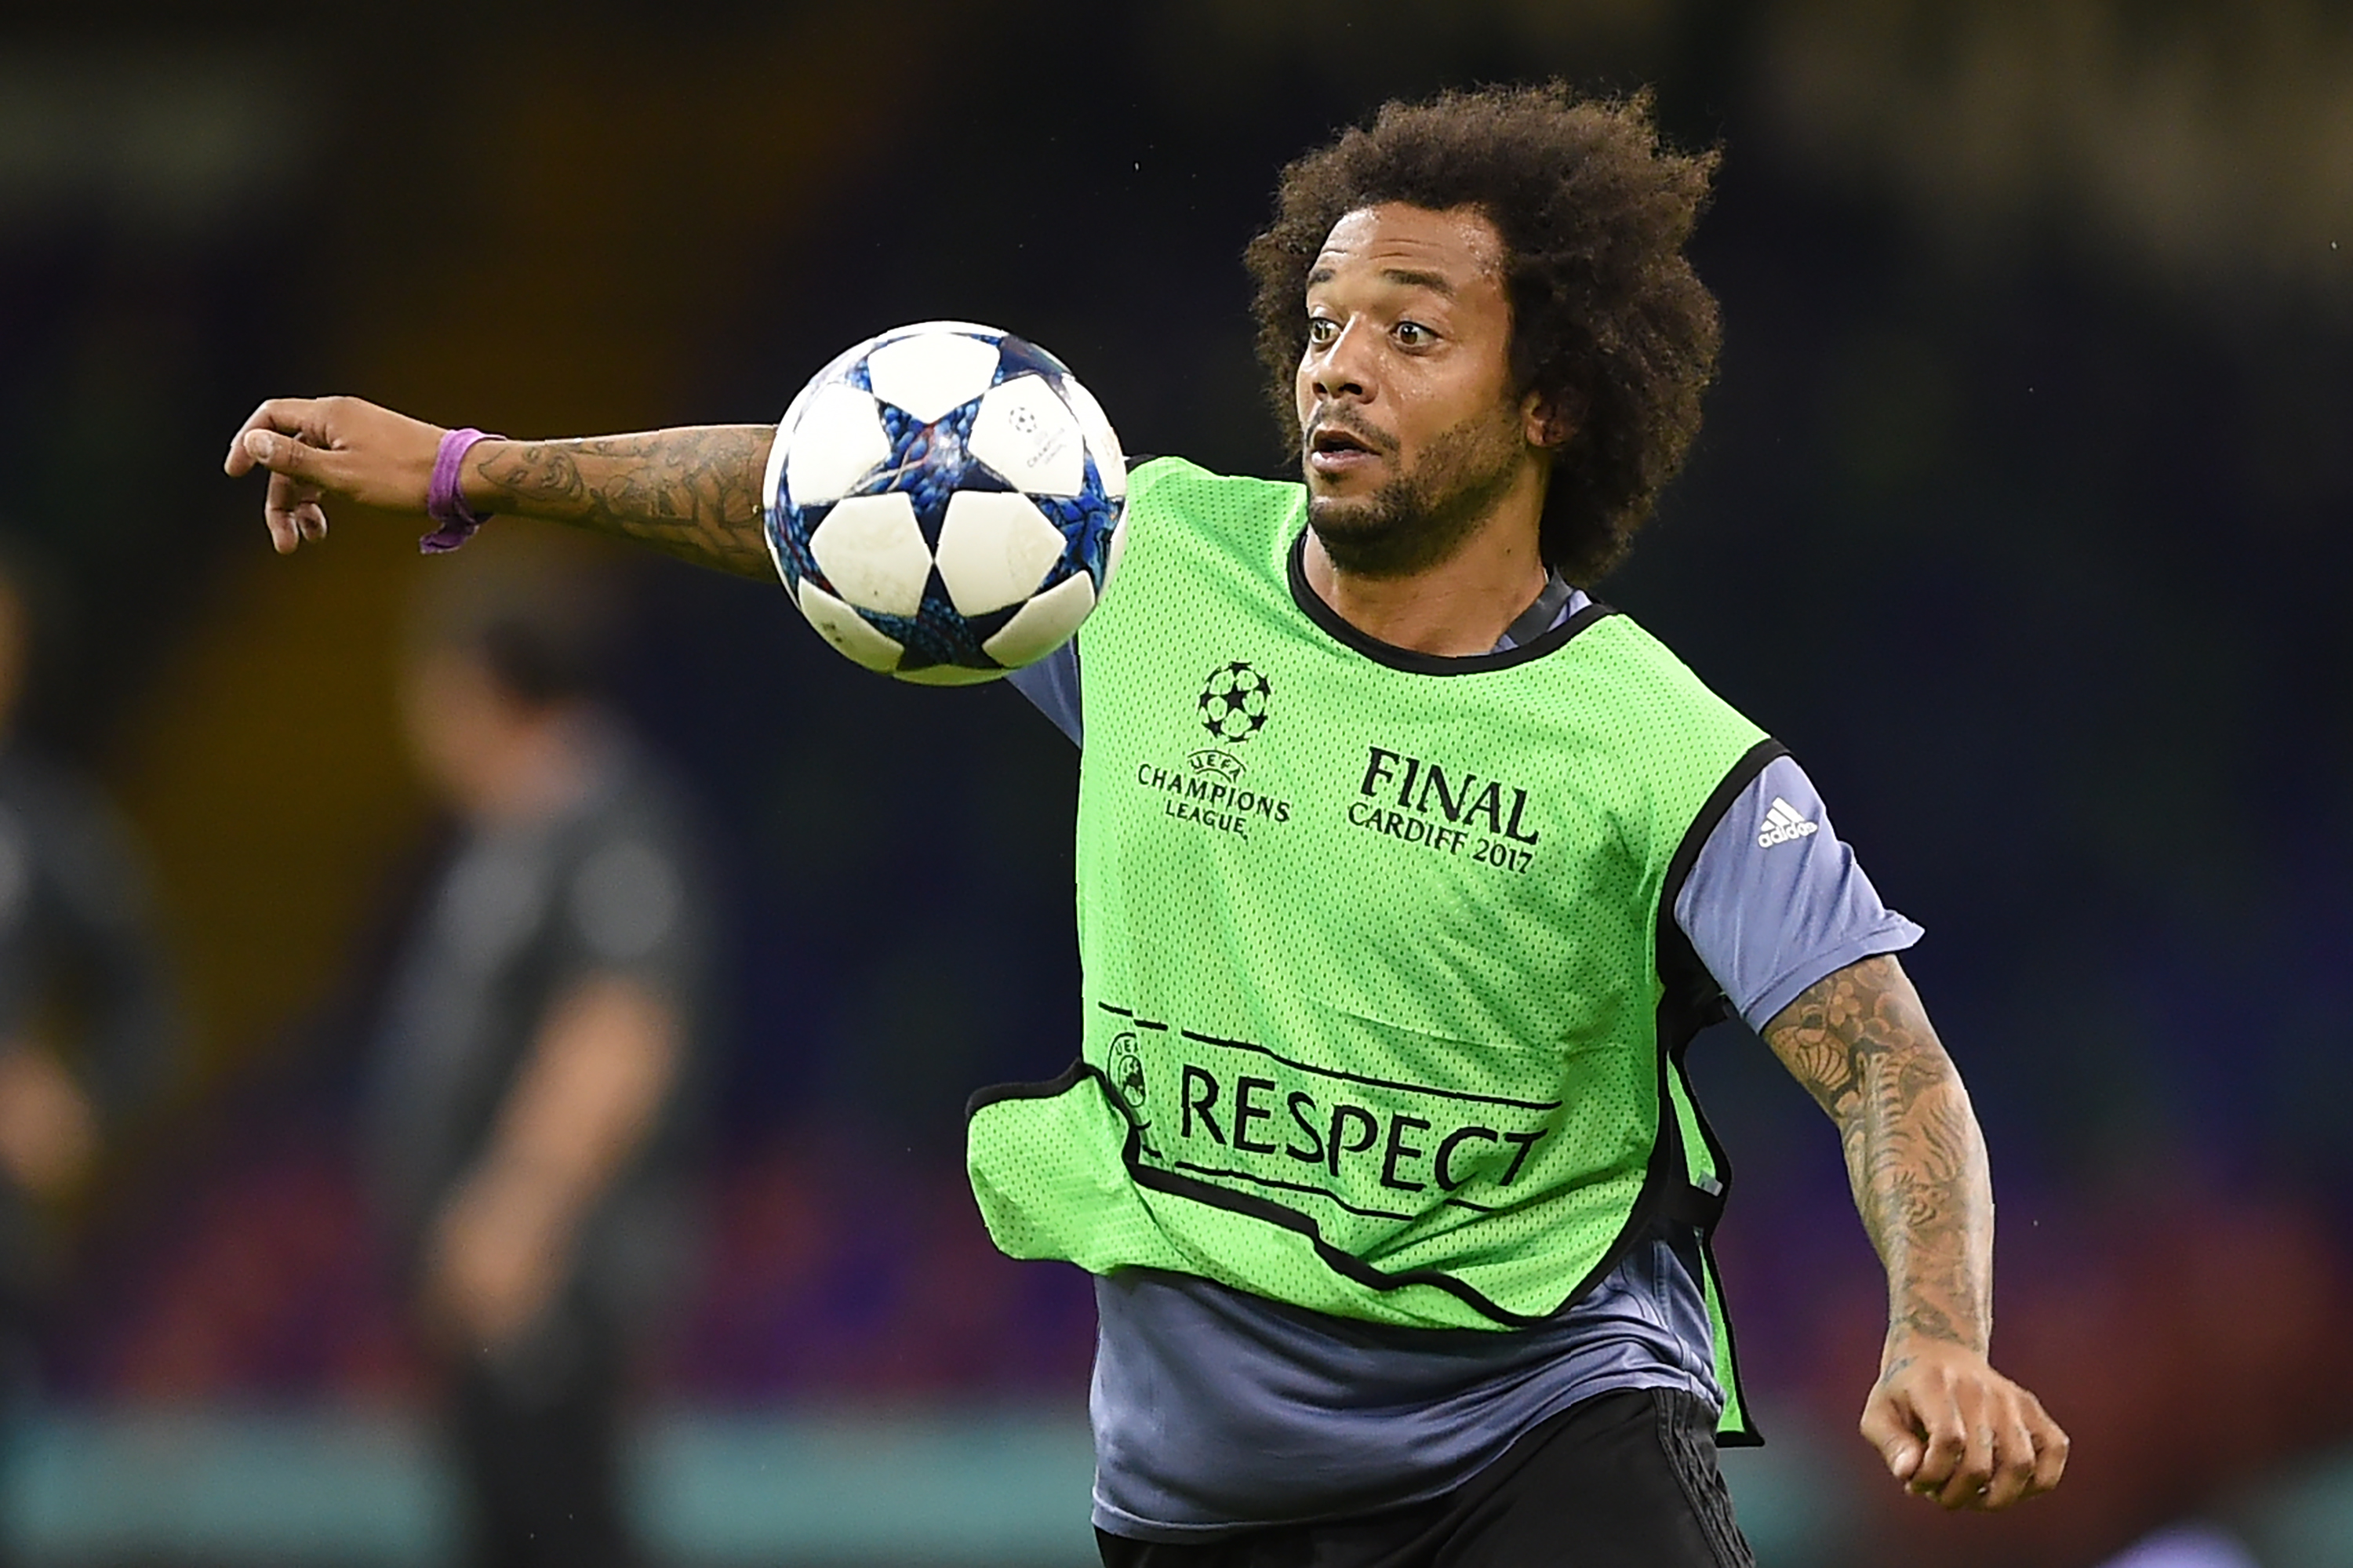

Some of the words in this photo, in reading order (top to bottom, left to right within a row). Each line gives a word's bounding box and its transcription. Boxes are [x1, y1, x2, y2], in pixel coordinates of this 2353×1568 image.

[1138, 763, 1290, 823] CHAMPIONS
[1190, 754, 1241, 783] UEFA
[1361, 746, 1539, 845] FINAL
[1348, 802, 1468, 855] CARDIFF
[1472, 838, 1533, 874] 2017
[1758, 821, 1818, 848] adidas
[1181, 1064, 1548, 1191] RESPECT
